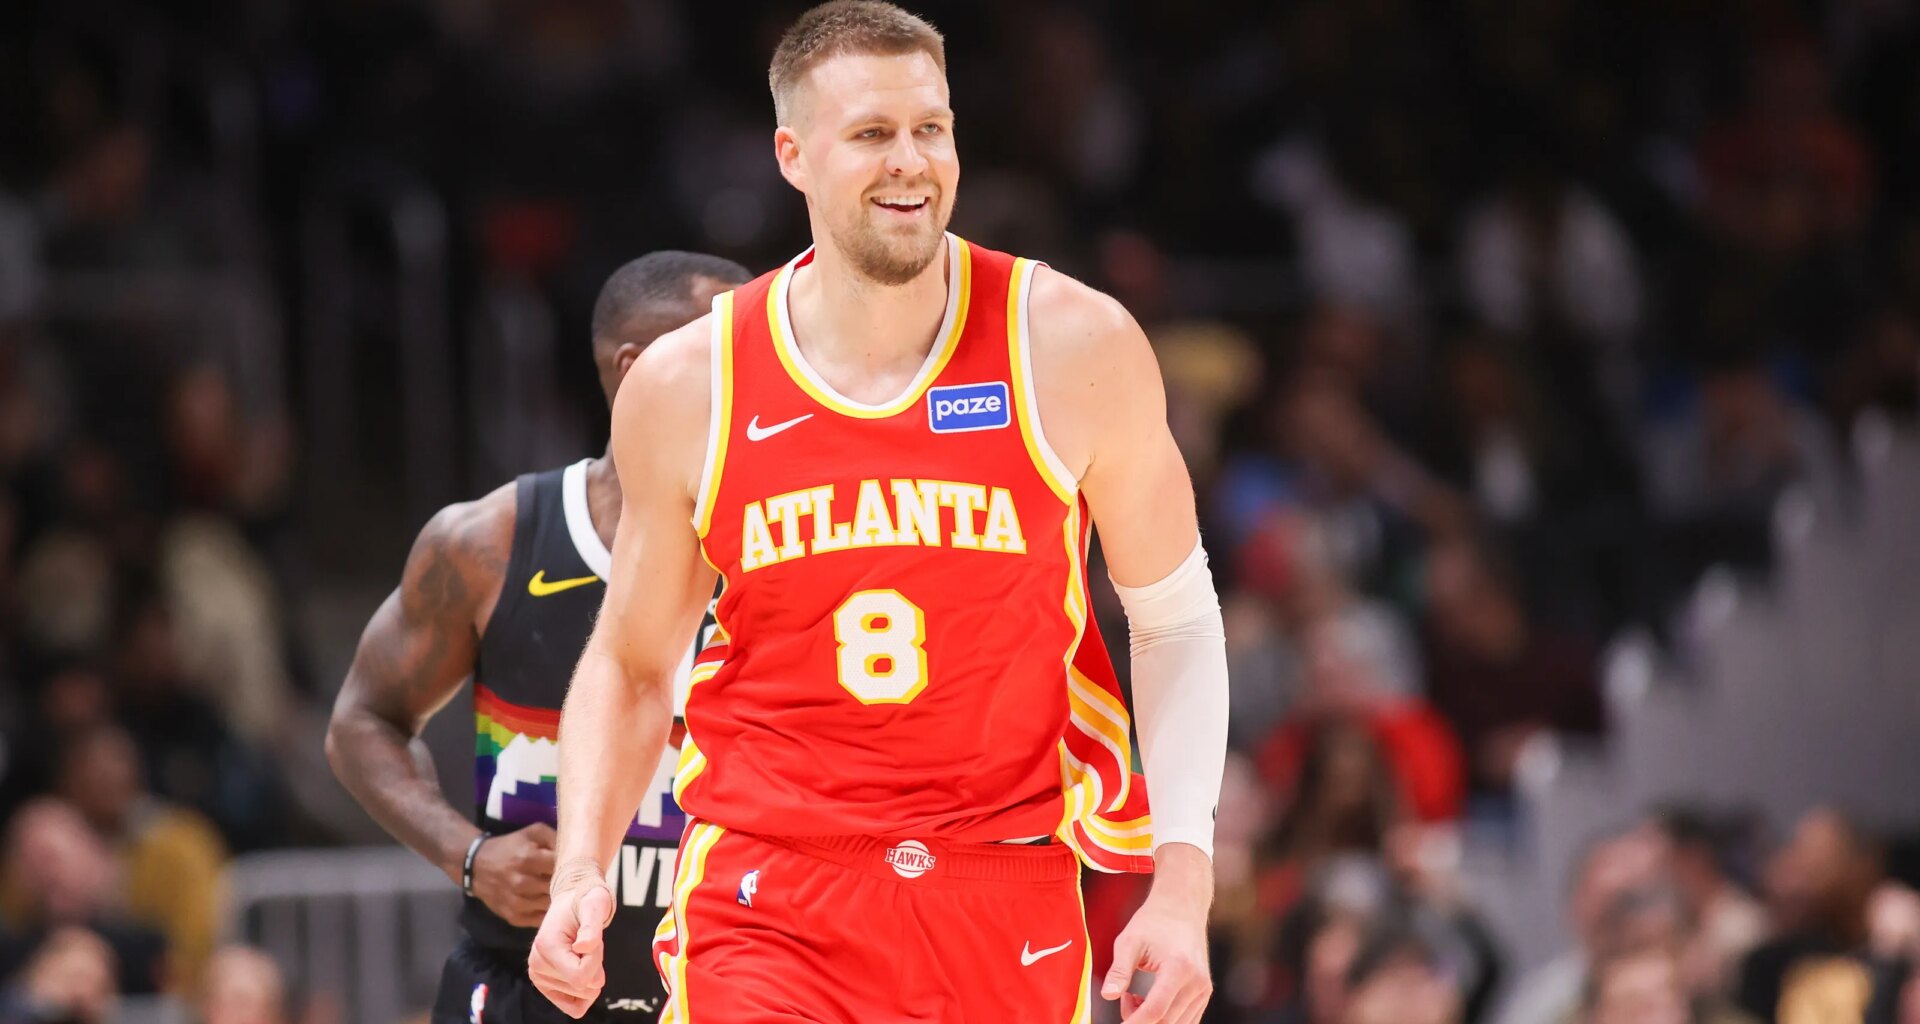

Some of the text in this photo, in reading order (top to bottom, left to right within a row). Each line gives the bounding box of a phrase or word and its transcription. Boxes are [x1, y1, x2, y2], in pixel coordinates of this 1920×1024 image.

[936, 395, 1001, 421] paze
[741, 479, 1026, 573] ATLANTA
[833, 589, 928, 705] 8
[886, 848, 935, 869] HAWKS
